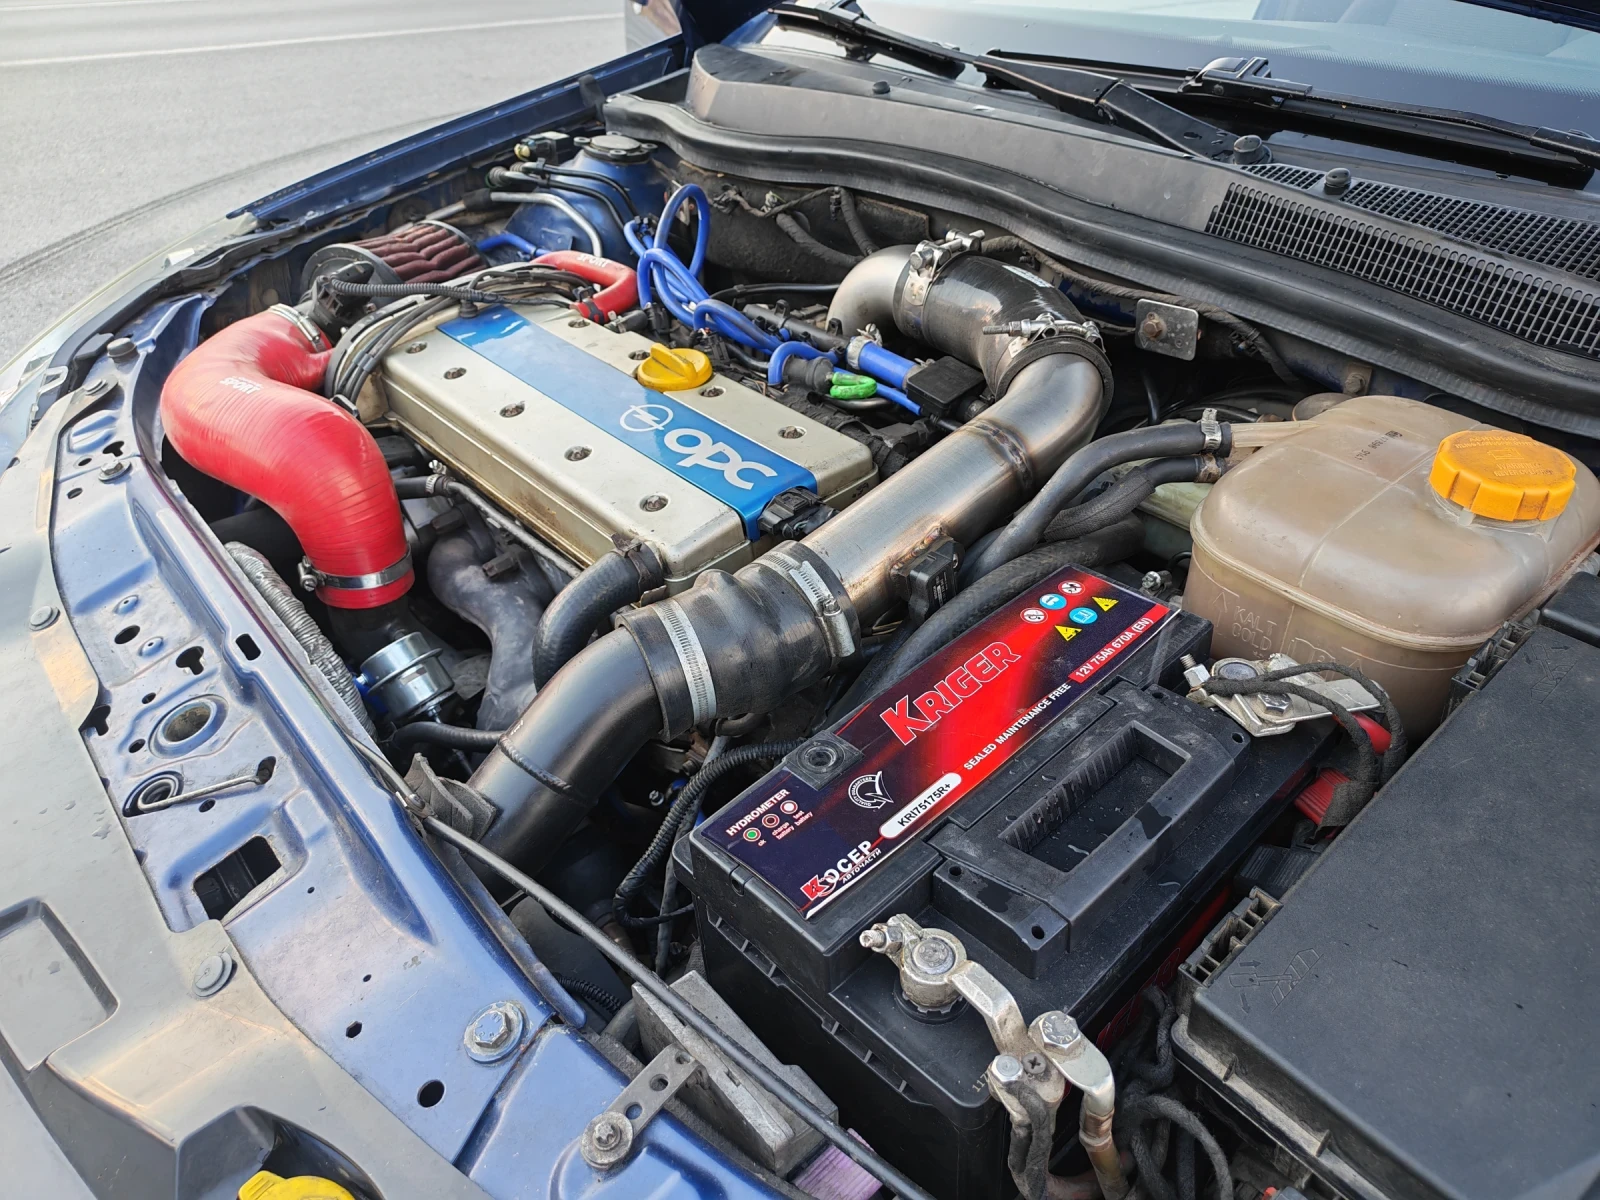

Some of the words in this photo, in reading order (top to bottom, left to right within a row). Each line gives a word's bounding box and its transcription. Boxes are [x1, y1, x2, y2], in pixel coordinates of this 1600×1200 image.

[1232, 622, 1272, 651] COLD
[1233, 606, 1277, 636] KALT
[1075, 661, 1094, 679] 12V
[1092, 645, 1115, 668] 75Ah
[1112, 629, 1135, 651] 670A
[1132, 616, 1155, 635] (EN)
[879, 641, 1022, 746] KRIGER
[963, 742, 997, 771] SEALED
[994, 696, 1052, 745] MAINTENANCE
[1049, 682, 1072, 702] FREE
[725, 788, 791, 837] HYDROMETER
[897, 782, 952, 828] KRI75175R+
